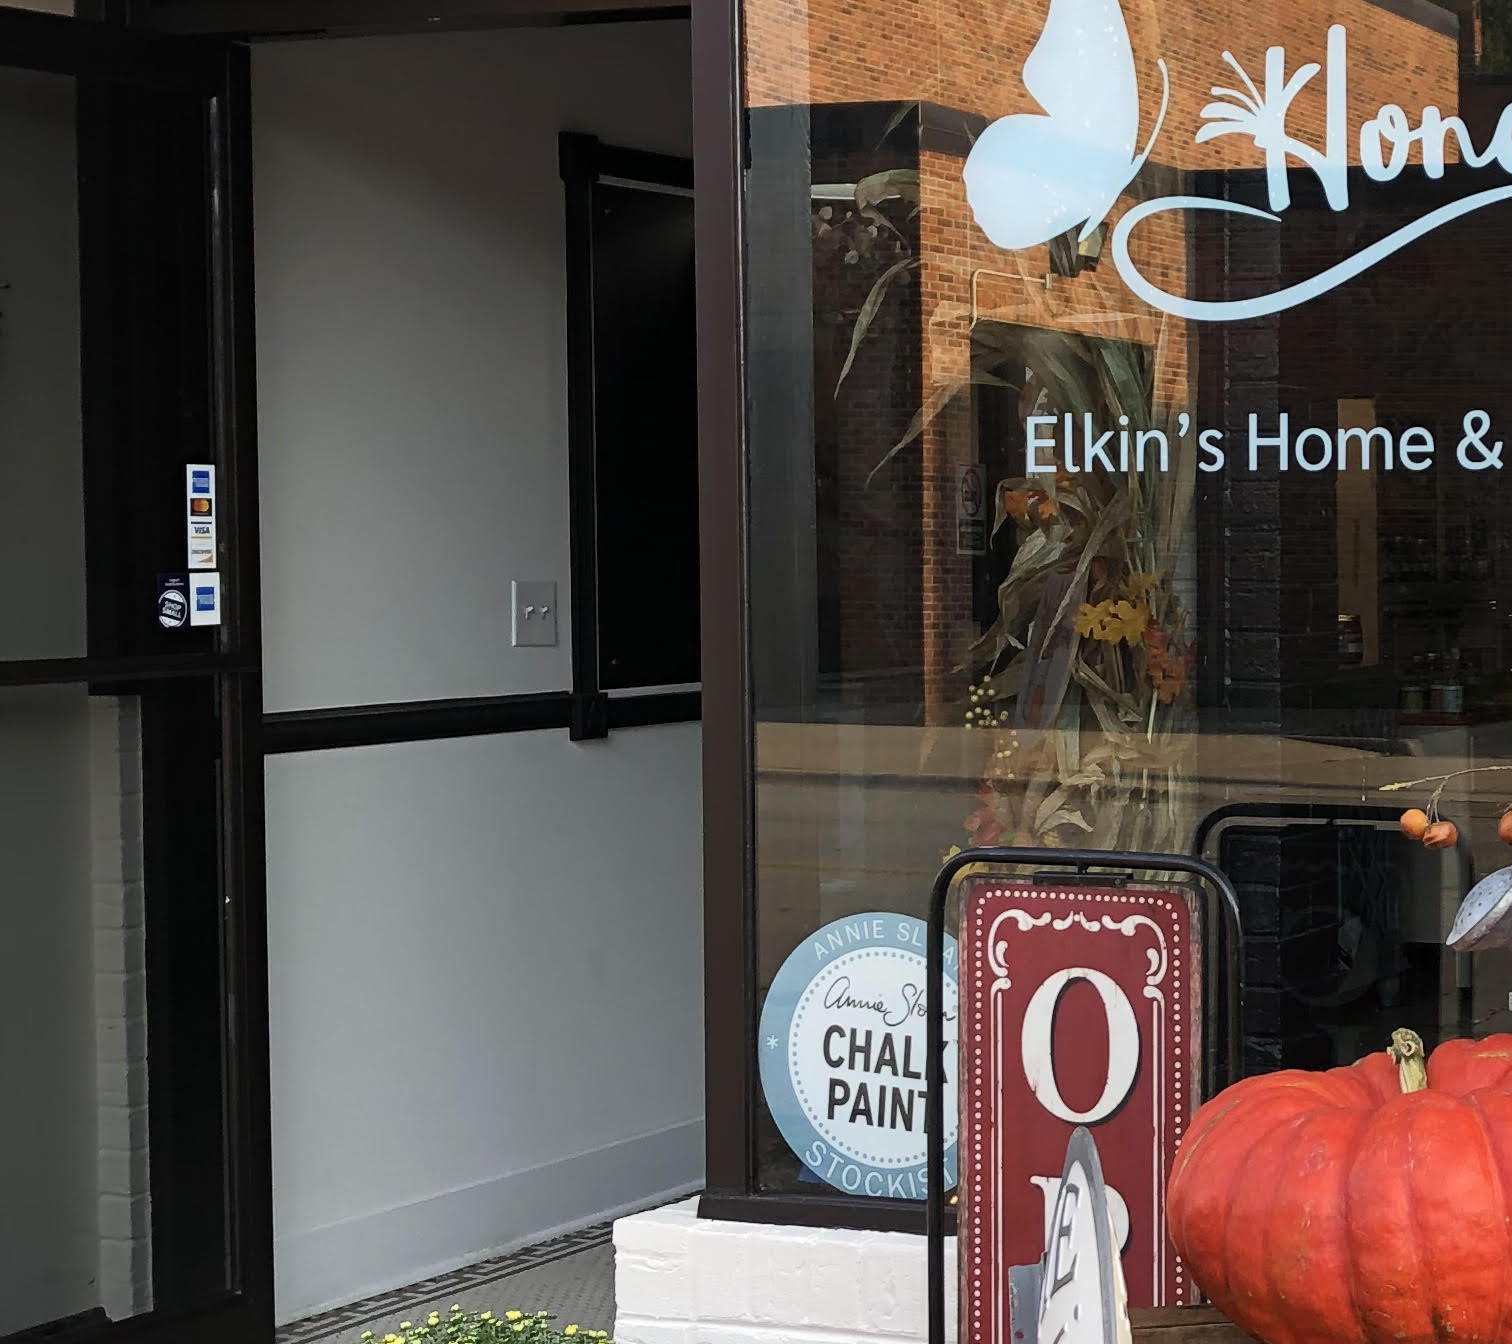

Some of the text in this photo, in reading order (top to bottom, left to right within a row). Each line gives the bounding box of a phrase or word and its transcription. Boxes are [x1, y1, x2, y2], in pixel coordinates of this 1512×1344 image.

[1025, 411, 1224, 474] Elkin's
[1247, 412, 1435, 472] Home
[1456, 409, 1504, 472] &
[194, 526, 210, 534] VISA
[814, 920, 885, 960] ANNIE
